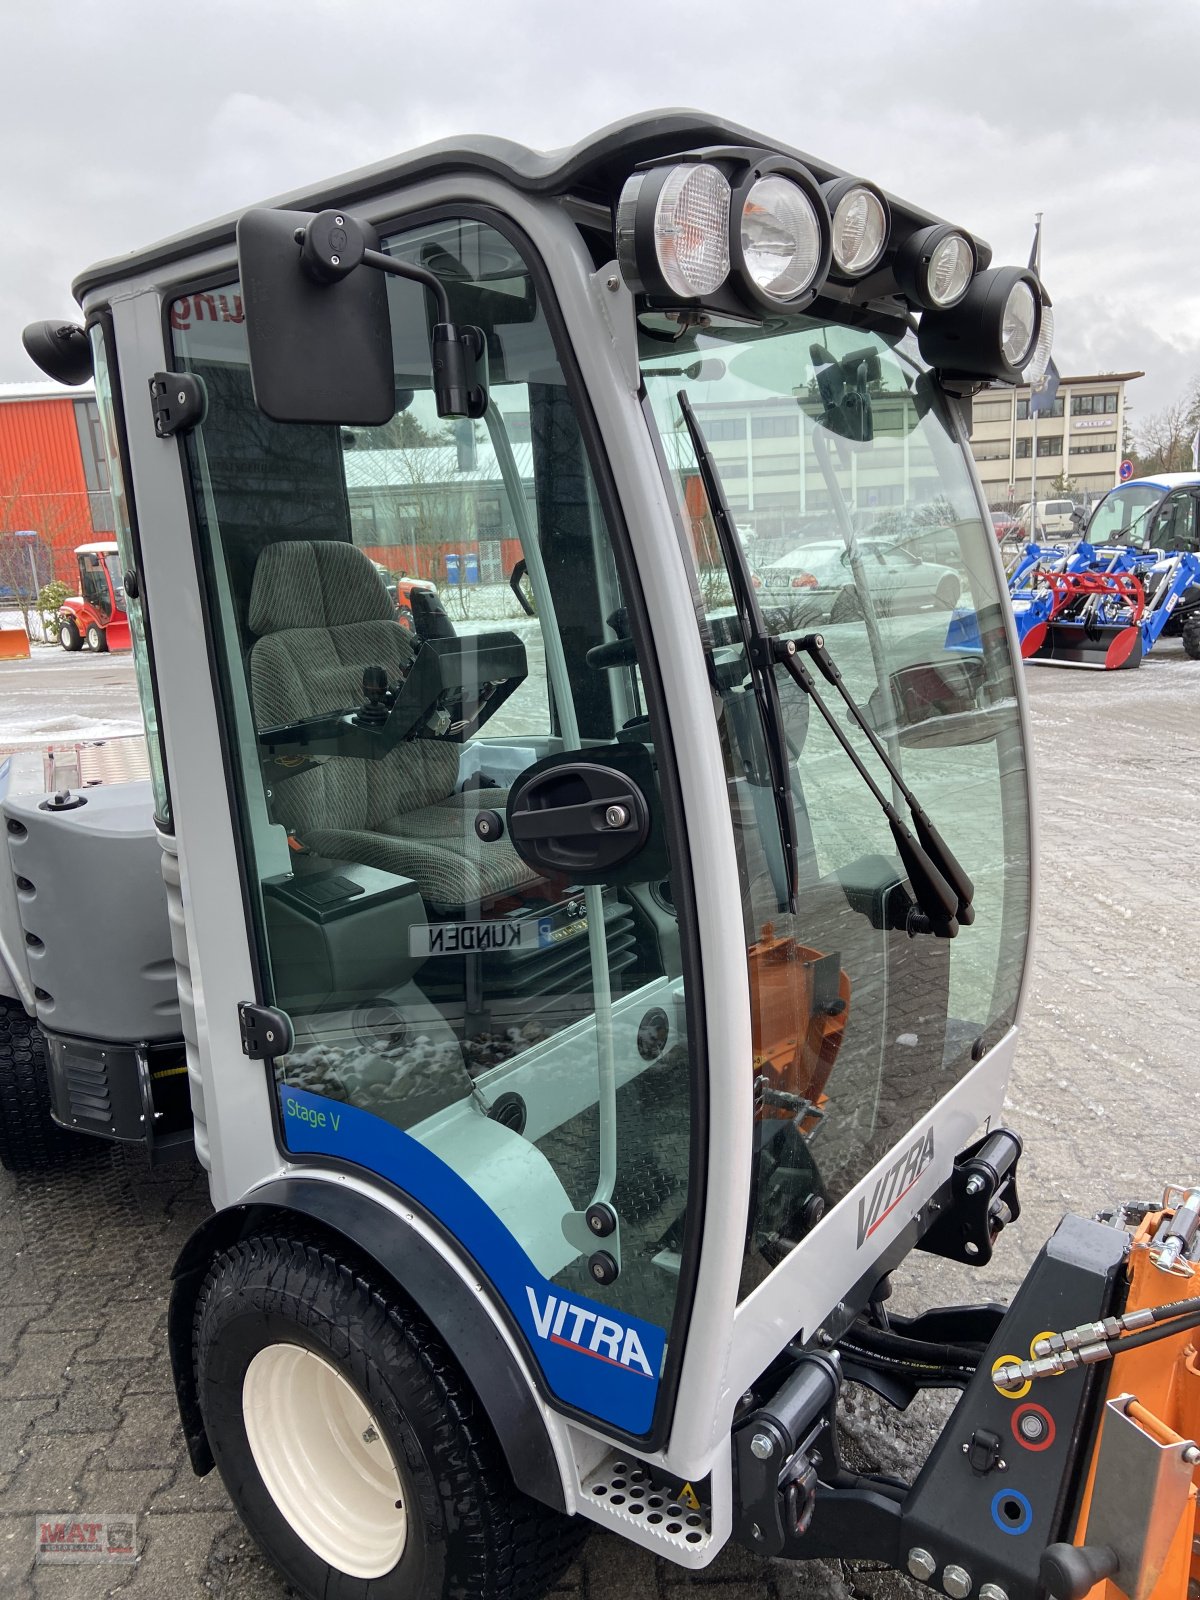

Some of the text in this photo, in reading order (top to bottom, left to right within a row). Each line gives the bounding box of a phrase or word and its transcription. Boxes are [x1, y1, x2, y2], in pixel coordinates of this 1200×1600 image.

[287, 1098, 340, 1131] Stage V
[857, 1125, 934, 1250] VITRA
[525, 1285, 653, 1376] VITRA
